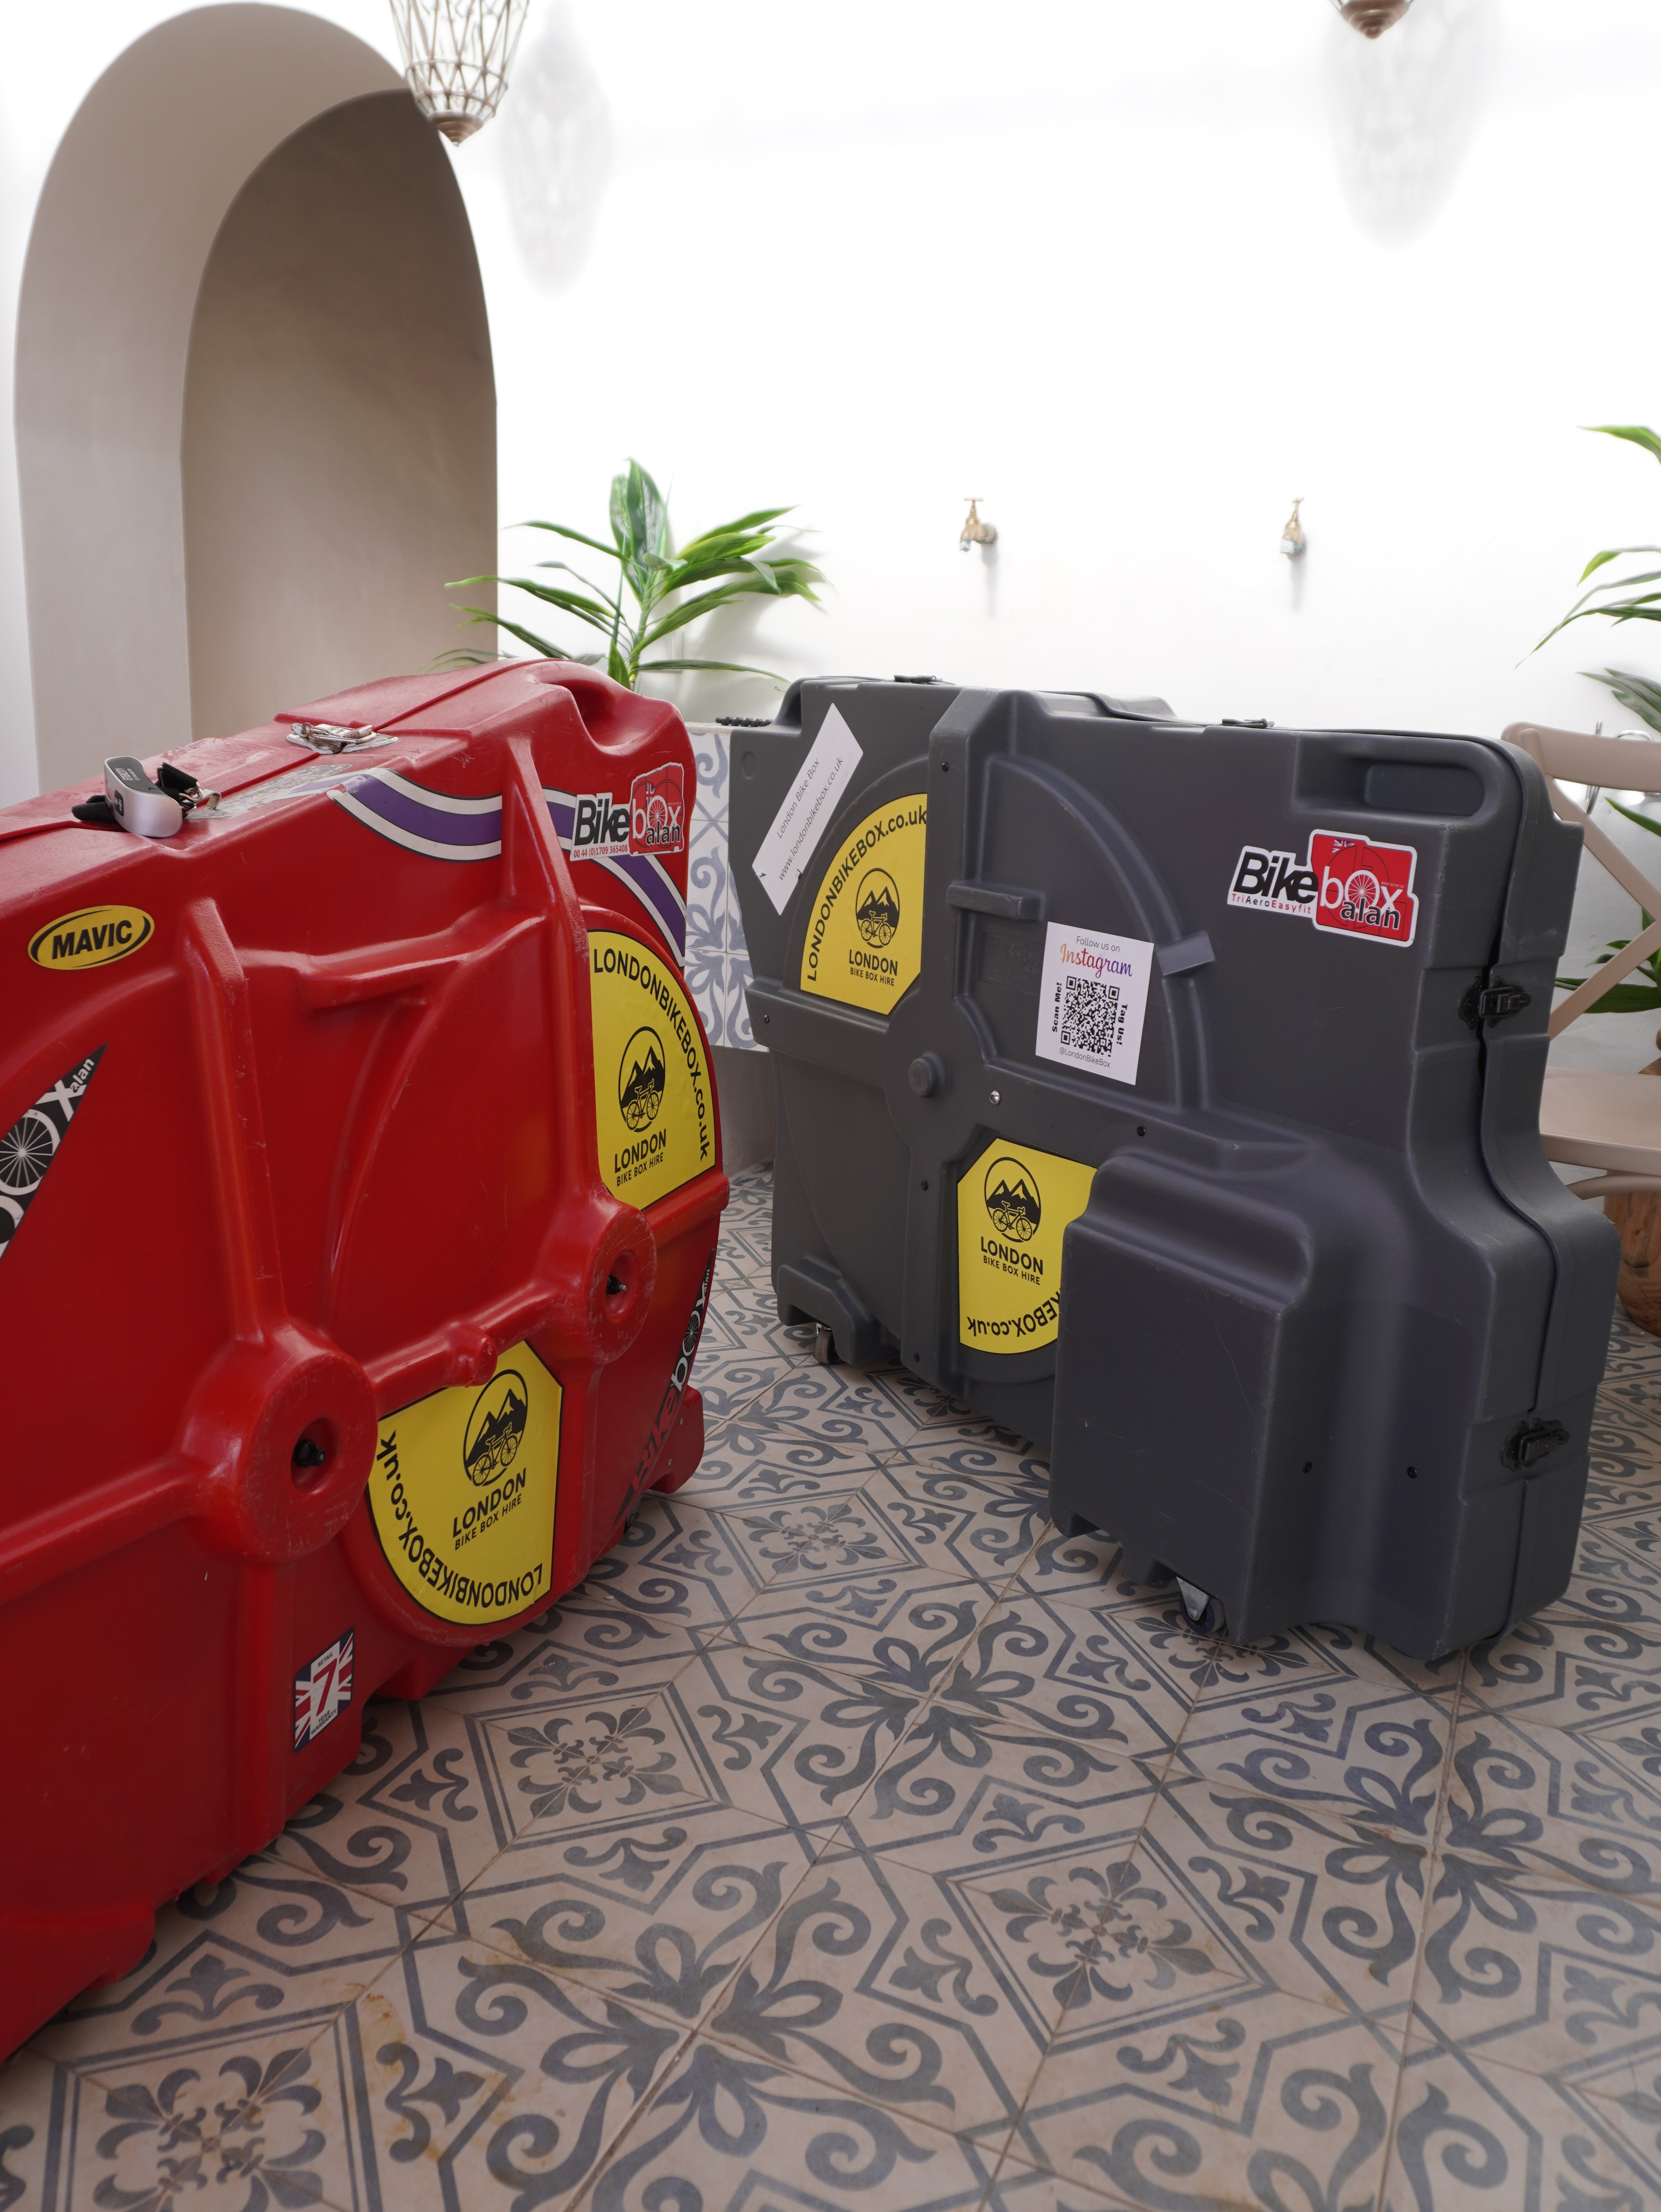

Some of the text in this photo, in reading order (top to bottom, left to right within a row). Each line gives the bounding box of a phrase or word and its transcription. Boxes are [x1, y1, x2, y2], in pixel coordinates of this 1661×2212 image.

[777, 758, 820, 839] London Bike Box
[646, 820, 681, 845] alan
[779, 756, 844, 881] www.londonbikebox.co.uk
[574, 849, 580, 858] 00
[589, 846, 608, 857] (0)1709
[609, 844, 628, 854] 365408
[807, 805, 927, 981] LONDONBIKEBOX.co.uk
[1231, 893, 1311, 915] TriAeroEasyfit
[1340, 897, 1401, 930] alan
[51, 920, 132, 960] MAVIC
[1076, 936, 1100, 948] Follow
[1111, 945, 1120, 953] on
[849, 949, 898, 976] LONDON
[850, 967, 895, 986] BIKE BOX HIRE
[1060, 943, 1133, 978] Instagram
[1116, 1003, 1128, 1045] Tag Us!
[594, 948, 710, 1162] LONDONBIKEBOX.co.uk
[1059, 1047, 1111, 1068] @LondonBikeBox
[69, 1058, 94, 1093] alan
[615, 1128, 666, 1174] LONDON
[617, 1152, 664, 1187] BIKE BOX HIRE
[981, 1236, 1043, 1275] LONDON
[983, 1255, 1040, 1285] BIKE BOX HIRE
[376, 1429, 543, 1608] LONDONBIKEBOX.co.uk
[453, 1468, 526, 1538] LONDON
[455, 1494, 522, 1551] BIKE BOX HIRE
[318, 1652, 333, 1668] RETAIL
[313, 1658, 337, 1718] 7
[311, 1708, 337, 1735] WARRANTY
[318, 1710, 331, 1724] YEAR
